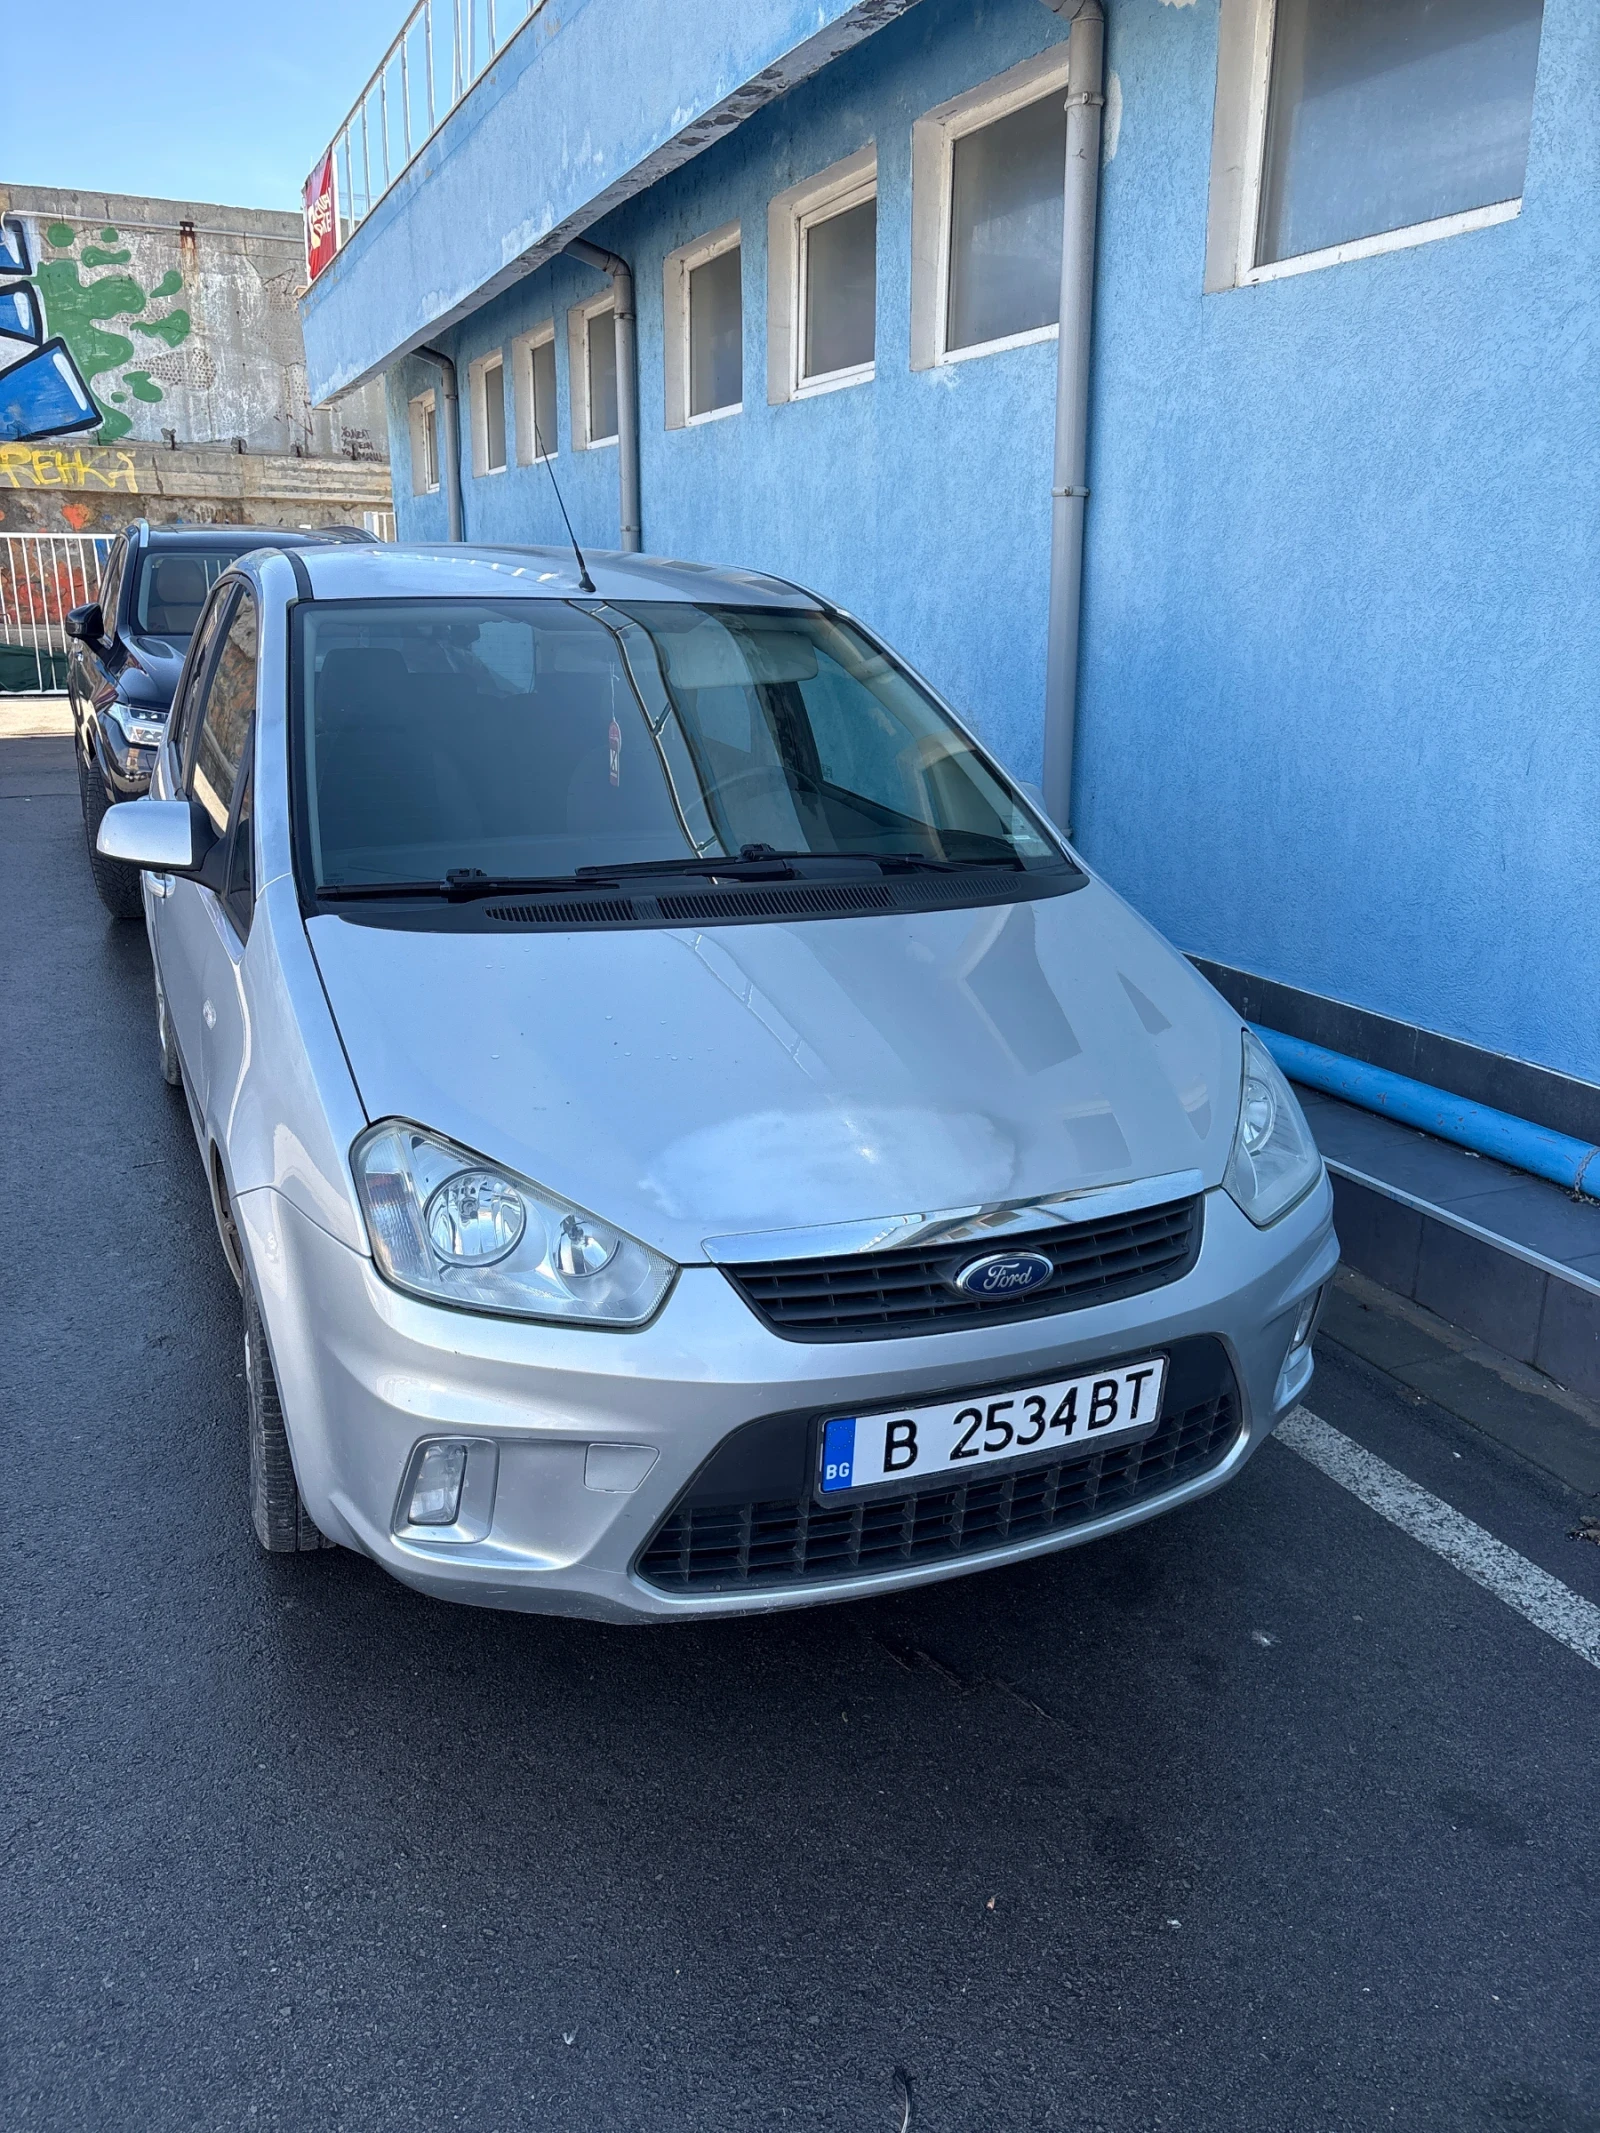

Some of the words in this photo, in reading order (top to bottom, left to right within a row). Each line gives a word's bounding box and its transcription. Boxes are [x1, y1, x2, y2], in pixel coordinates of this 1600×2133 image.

[982, 1262, 1032, 1291] Ford
[883, 1419, 919, 1473] B
[826, 1462, 850, 1481] BG
